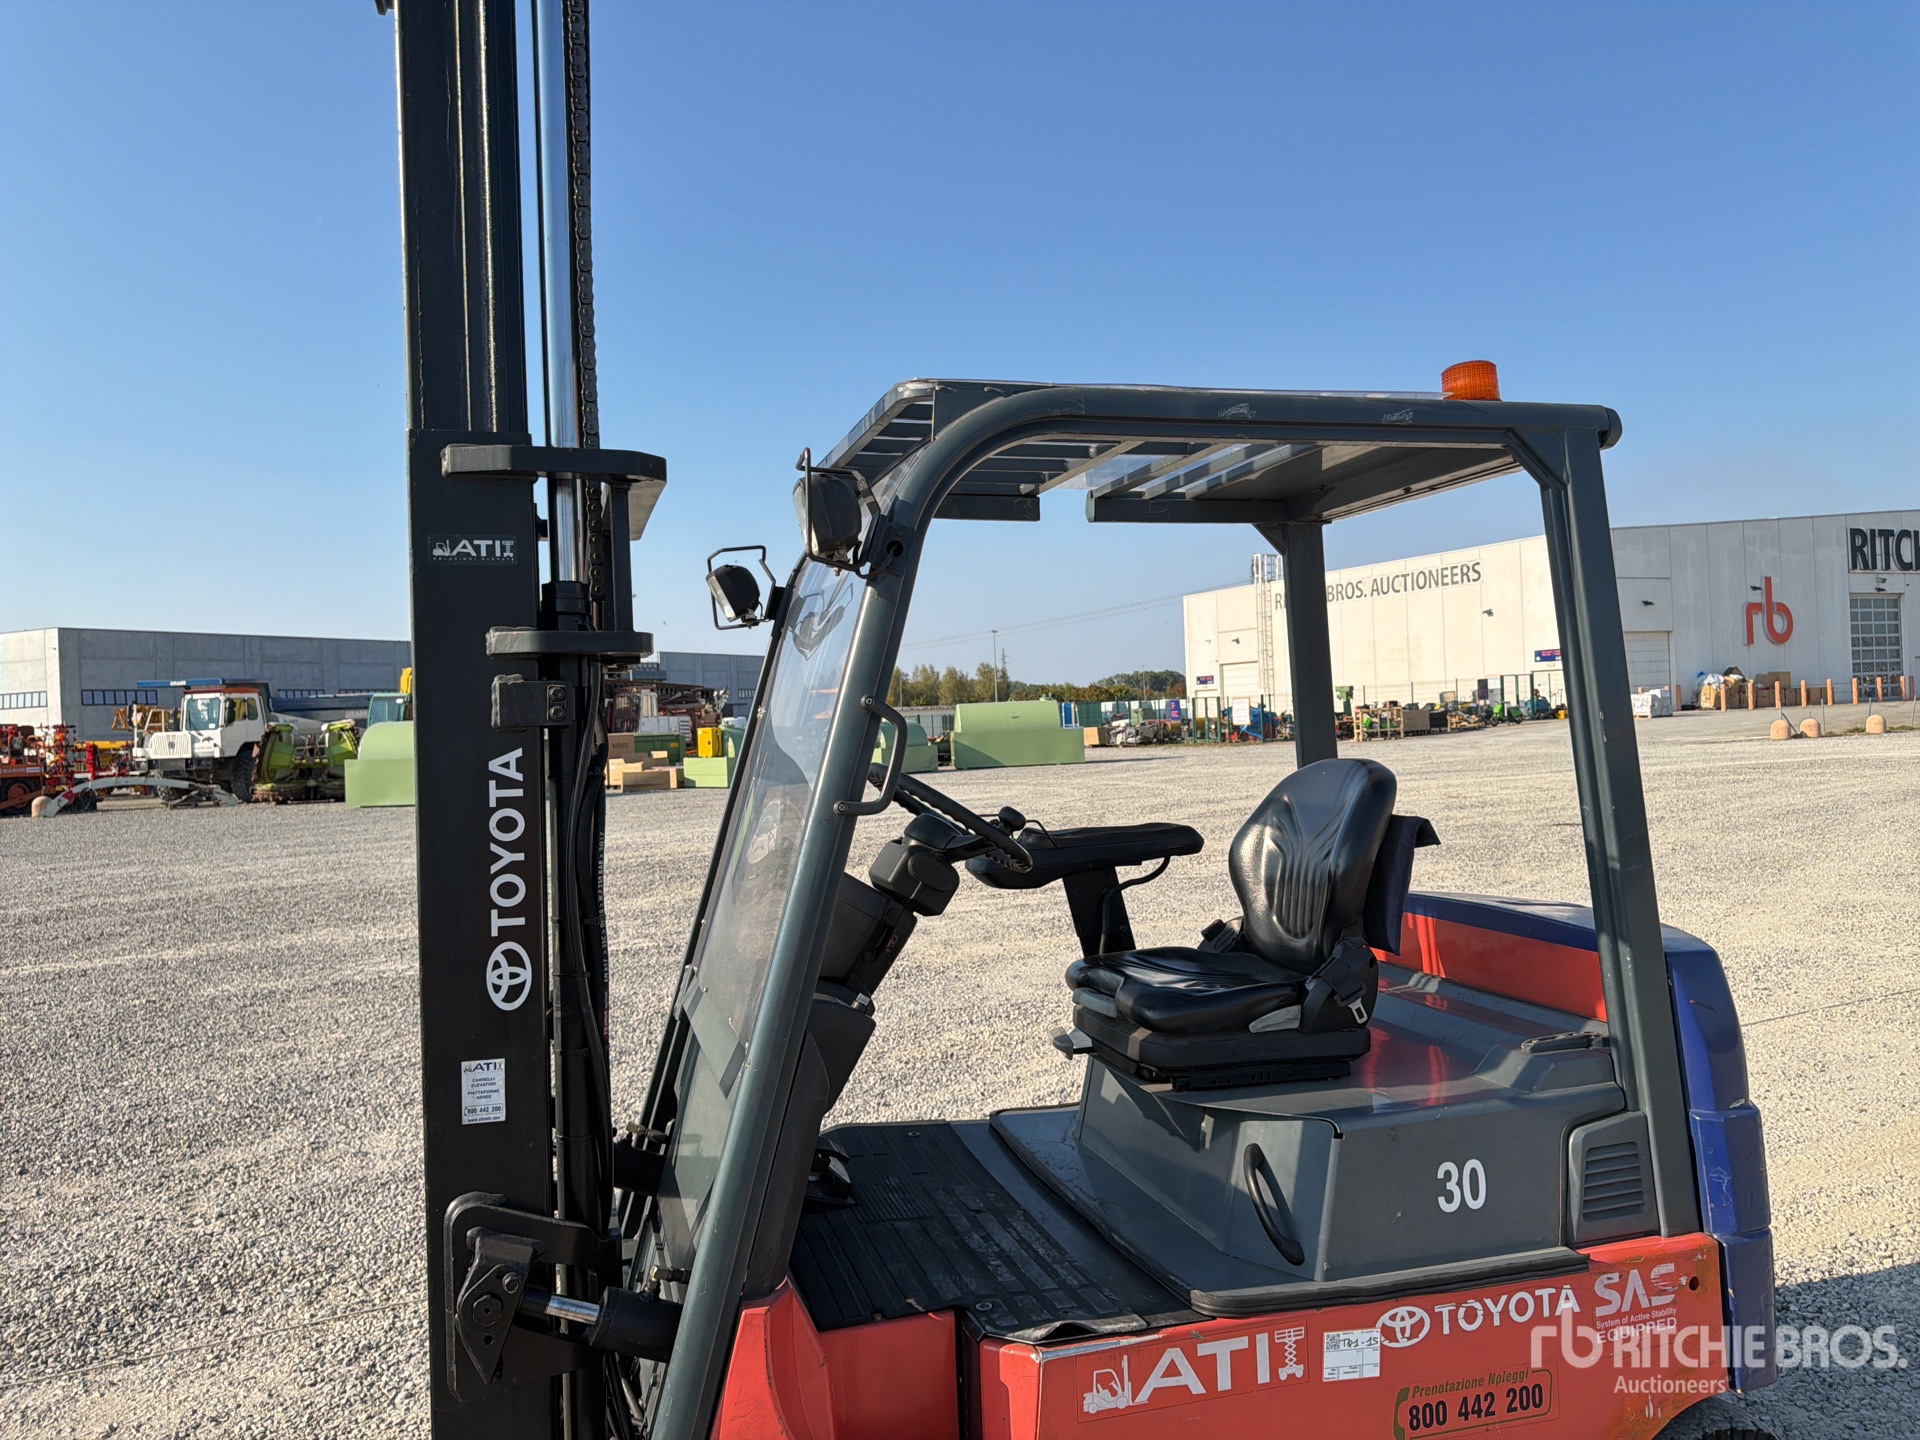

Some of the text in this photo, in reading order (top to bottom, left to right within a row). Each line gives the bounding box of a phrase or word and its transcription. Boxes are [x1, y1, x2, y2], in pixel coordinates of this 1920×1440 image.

[451, 539, 501, 557] ATI
[1327, 561, 1482, 602] BROS. AUCTIONEERS
[488, 747, 526, 937] TOYOTA
[472, 1062, 497, 1072] ATI
[1437, 1158, 1487, 1213] 30
[1434, 1284, 1581, 1335] TOYOTA
[1596, 1307, 1677, 1329] System of Active Stability
[1596, 1317, 1677, 1344] EQUIPPED
[1134, 1332, 1271, 1403] ATI
[1412, 1377, 1484, 1398] Prenotazione
[1409, 1383, 1544, 1431] 800 442 200
